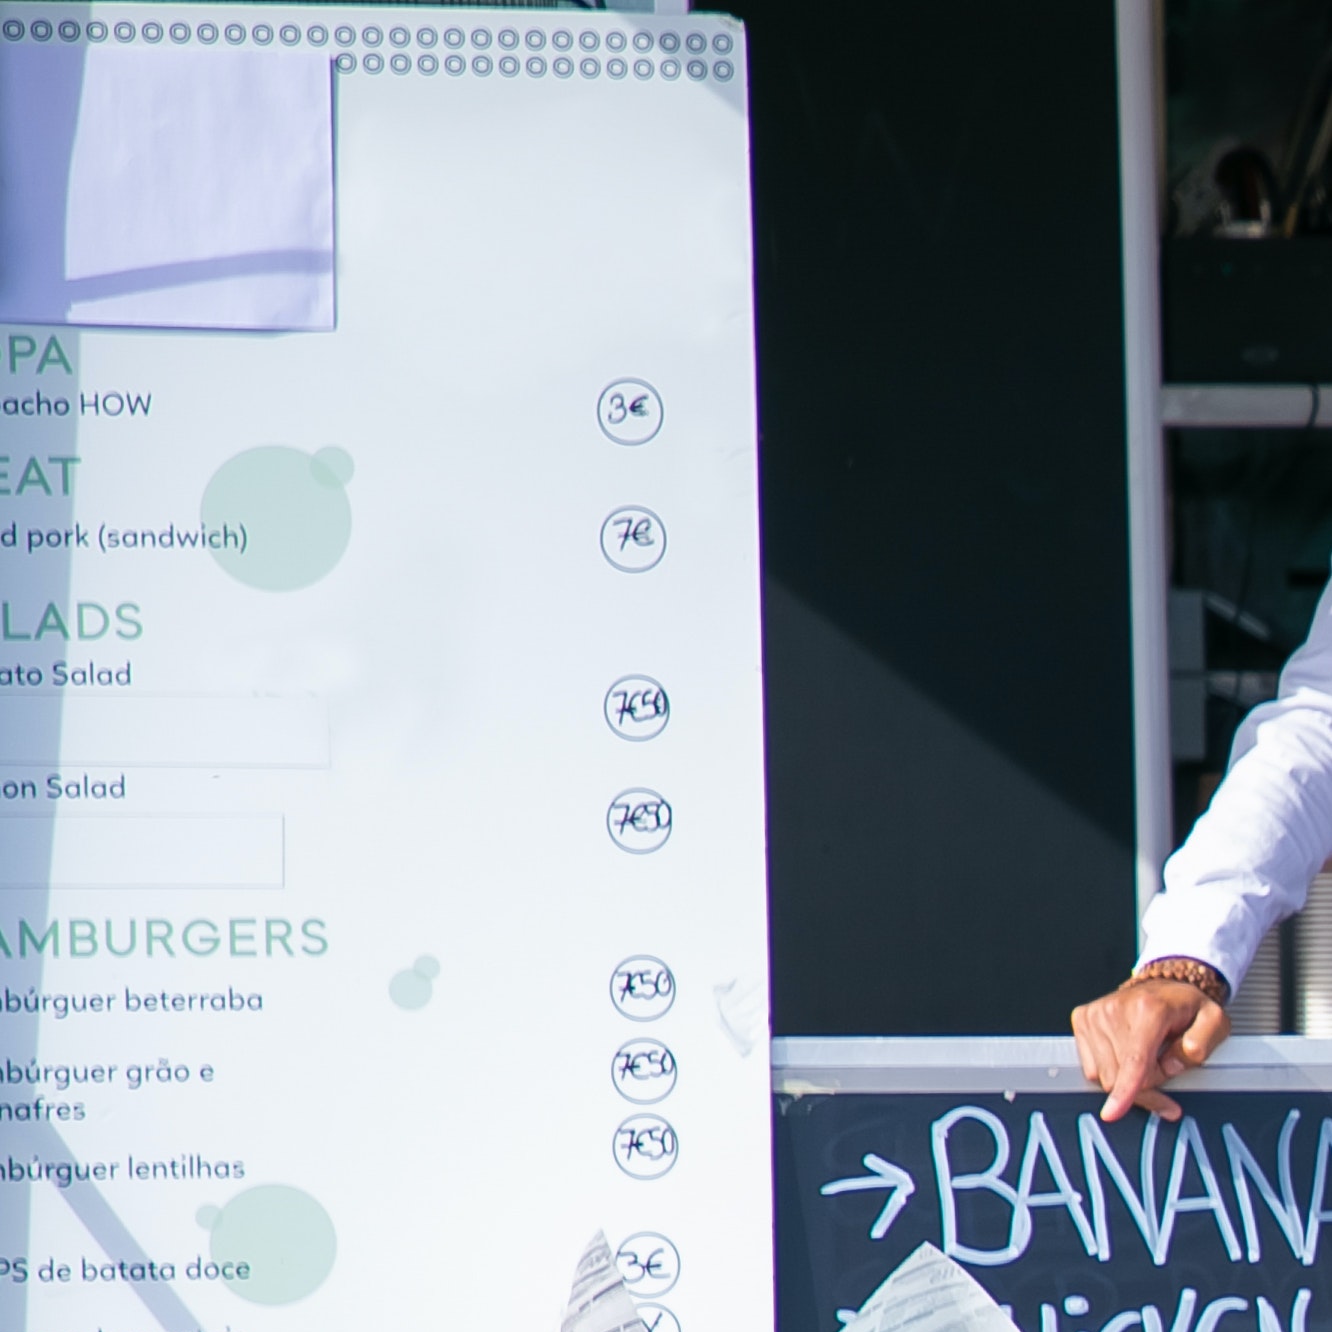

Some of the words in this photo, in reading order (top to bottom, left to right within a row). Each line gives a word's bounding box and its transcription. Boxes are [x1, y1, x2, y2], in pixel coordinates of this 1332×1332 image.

[0, 334, 73, 376] PA
[0, 388, 70, 416] acho
[80, 391, 152, 416] HOW
[607, 393, 650, 424] 3€
[27, 521, 89, 554] pork
[99, 521, 247, 553] (sandwich)
[612, 517, 655, 551] 7€
[1, 601, 144, 641] LADS
[52, 659, 131, 687] Salad
[46, 772, 126, 800] Salad
[0, 986, 117, 1019] búrguer
[125, 986, 263, 1012] beterraba
[616, 969, 672, 1003] 7€50
[0, 1058, 118, 1090] búrguer
[126, 1057, 190, 1090] grão
[199, 1064, 214, 1082] e
[616, 1047, 675, 1081] 7€50
[617, 1125, 676, 1161] 7€50
[0, 1154, 120, 1188] búrguer
[128, 1154, 245, 1180] lentilhas
[38, 1256, 71, 1282] de
[81, 1255, 176, 1281] batata
[185, 1254, 250, 1280] doce
[616, 1247, 671, 1284] 3€
